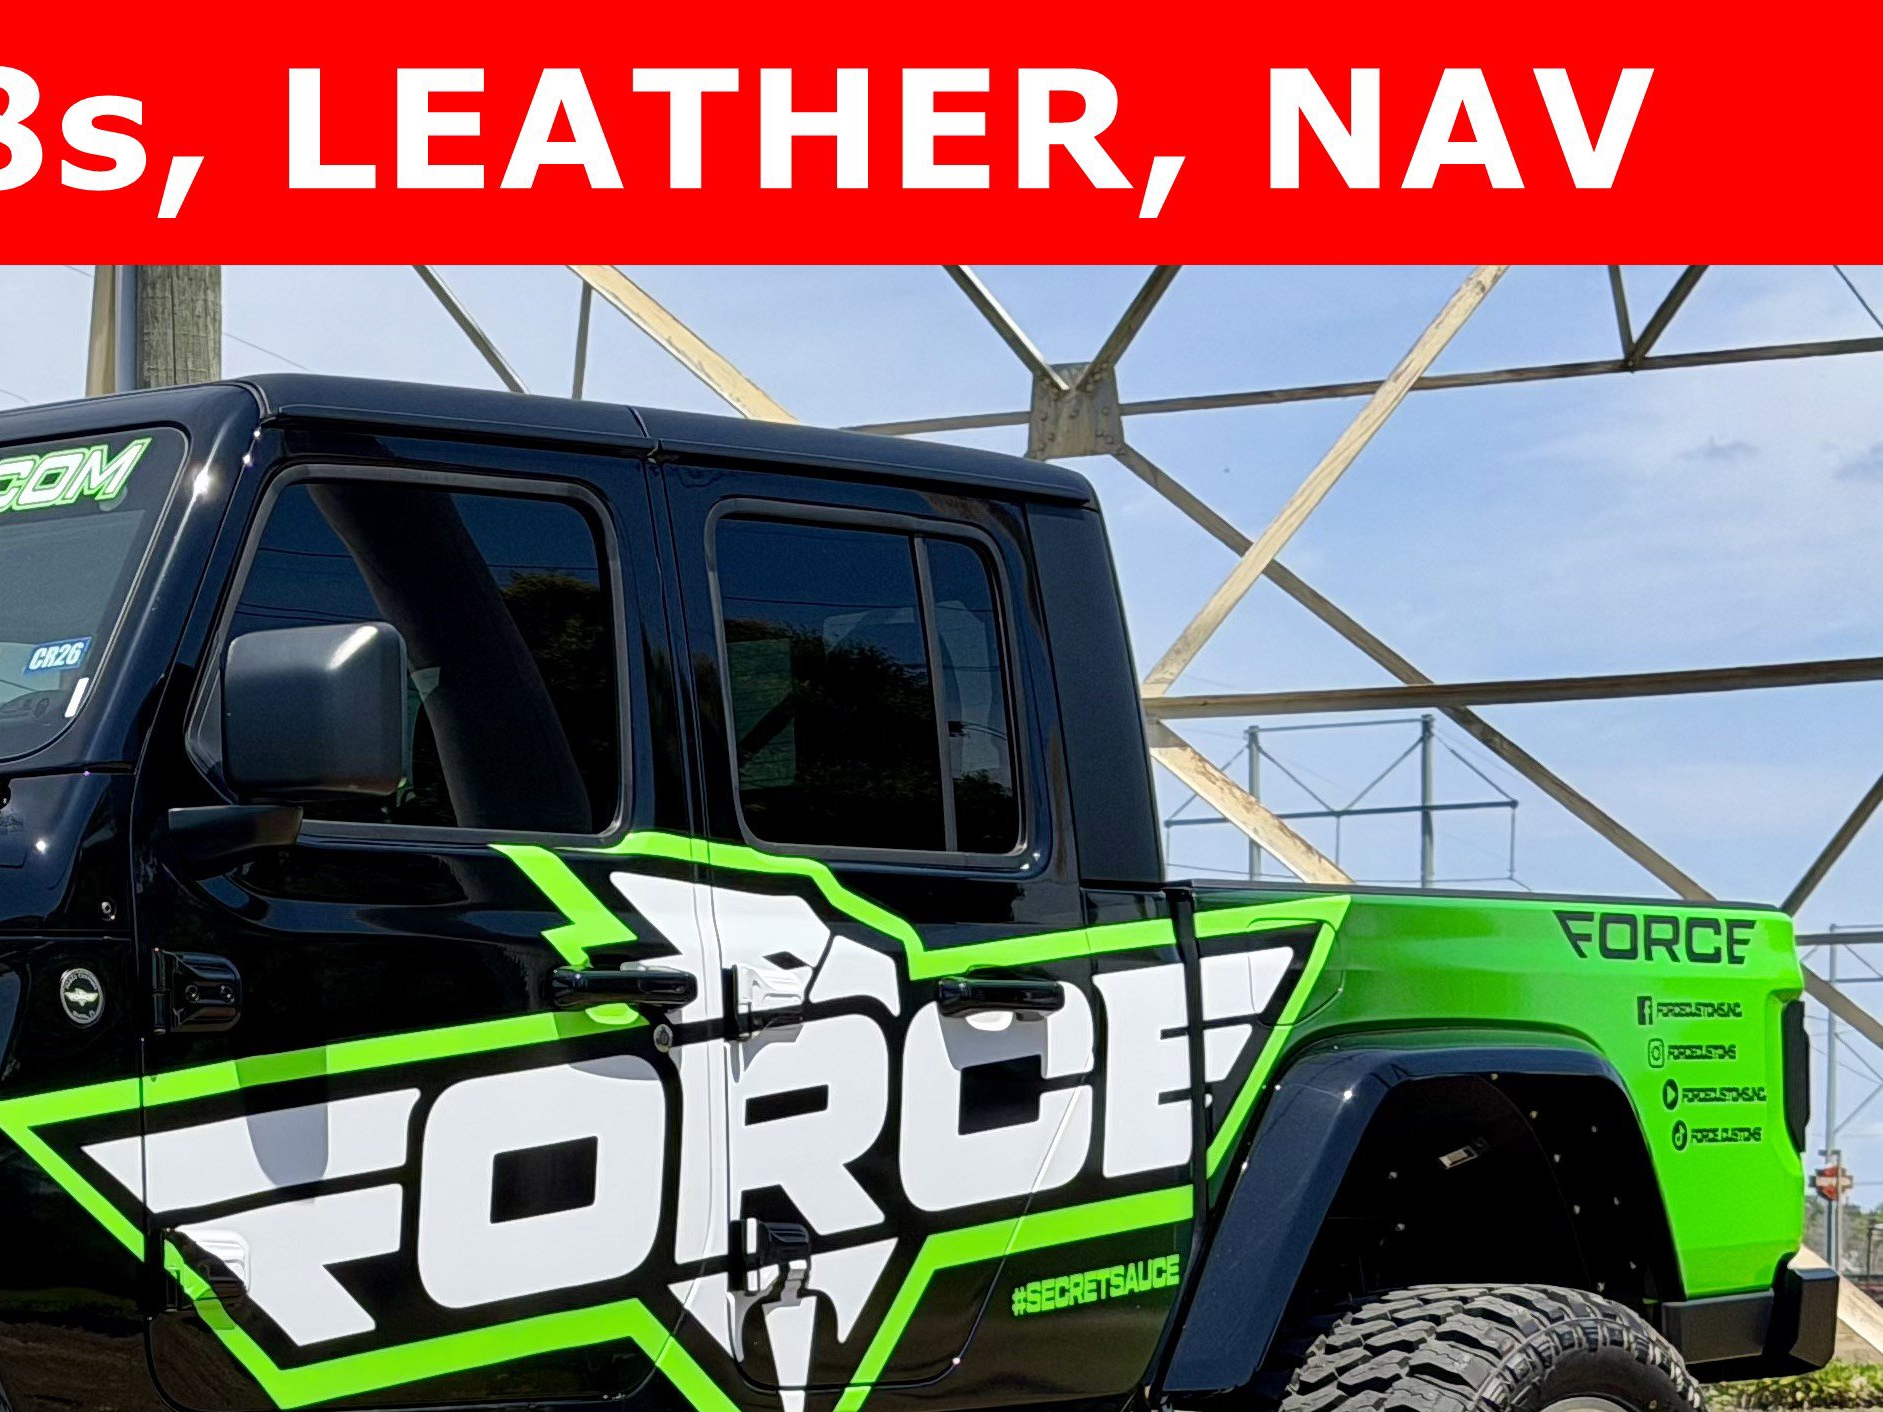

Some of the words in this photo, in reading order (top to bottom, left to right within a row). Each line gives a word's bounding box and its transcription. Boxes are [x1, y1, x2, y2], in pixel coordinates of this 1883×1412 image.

[29, 641, 85, 670] CR26
[1552, 910, 1758, 965] FORCE
[80, 946, 1295, 1346] FORCE
[1012, 1254, 1180, 1316] #SECRETSAUCE
